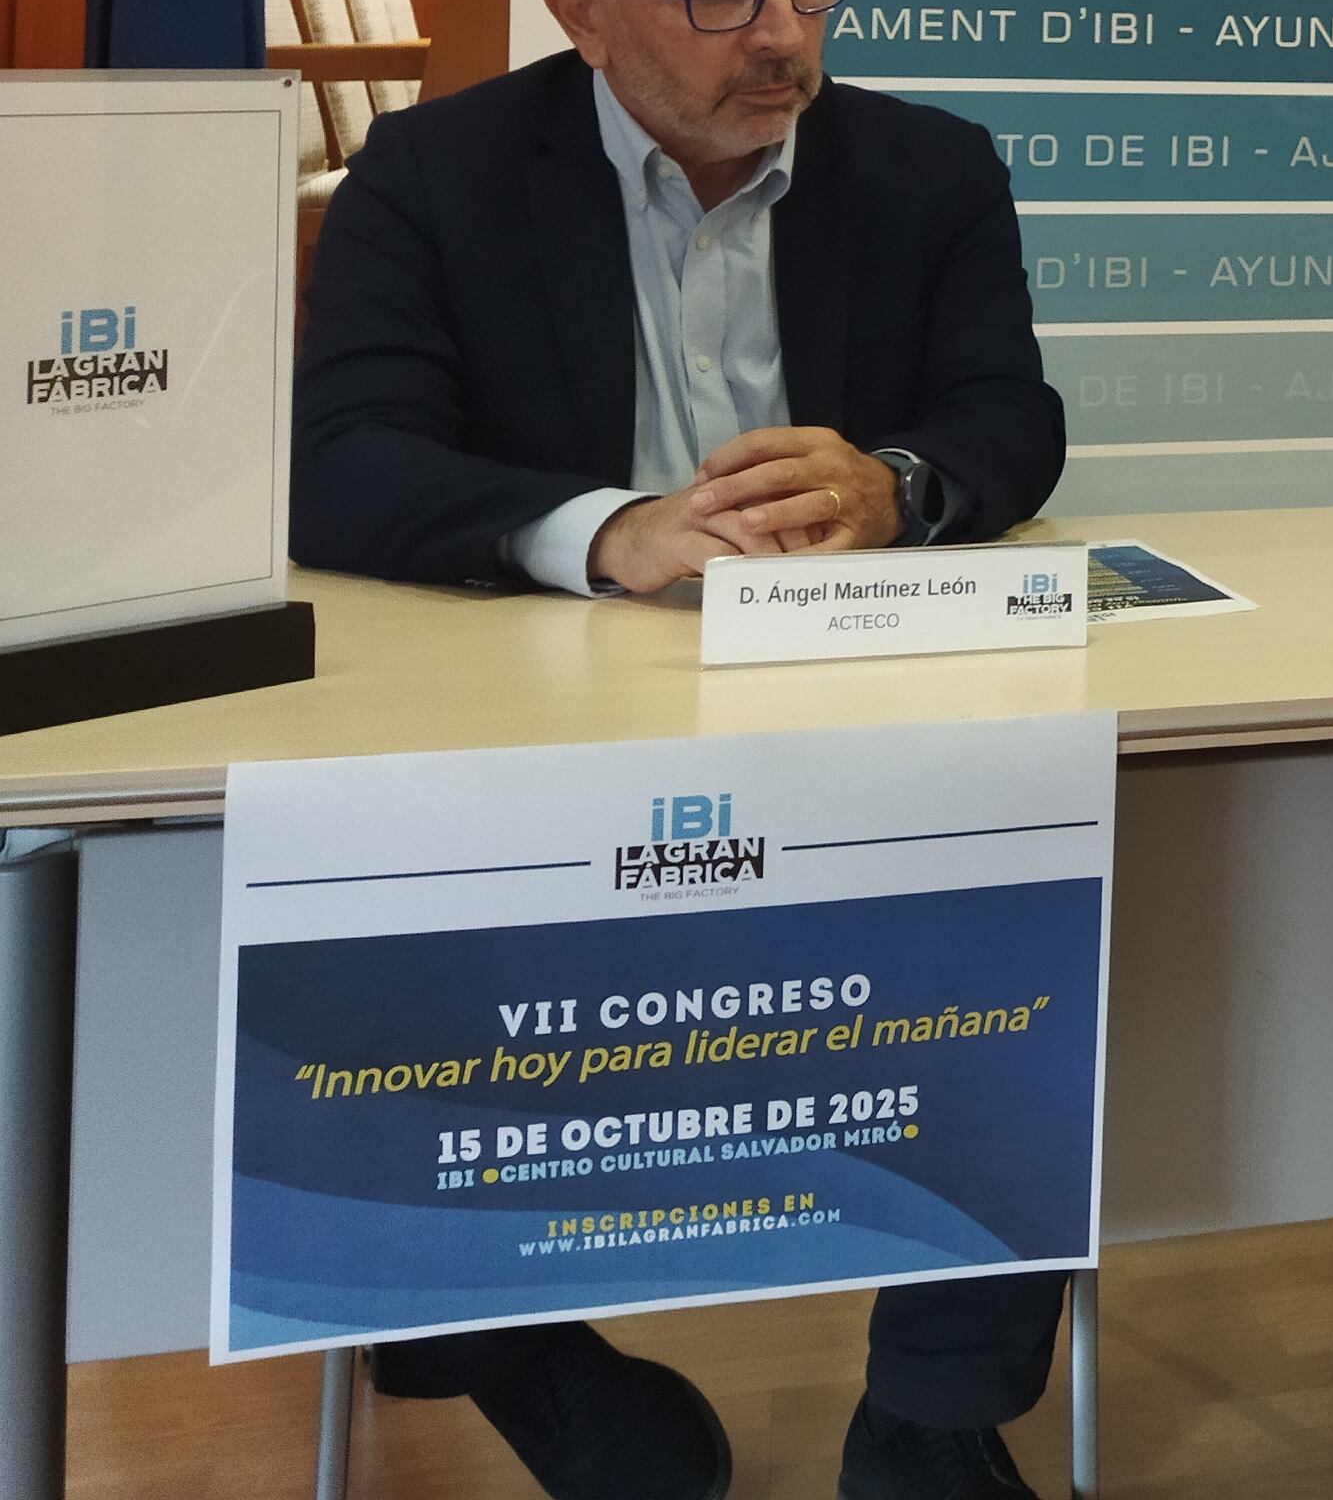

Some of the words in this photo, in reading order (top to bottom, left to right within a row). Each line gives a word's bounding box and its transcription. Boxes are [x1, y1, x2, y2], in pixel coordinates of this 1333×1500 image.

[1042, 7, 1153, 45] D'IBI
[1085, 134, 1144, 167] DE
[1171, 135, 1229, 167] IBI
[1036, 252, 1147, 289] D'IBI
[740, 586, 760, 604] D.
[767, 579, 827, 607] Ángel
[834, 579, 921, 600] Martínez
[928, 576, 976, 596] León
[827, 612, 900, 631] ACTECO
[498, 999, 577, 1038] VII
[599, 974, 871, 1029] CONGRESO
[294, 1058, 482, 1099] “Innovar
[490, 1046, 573, 1088] hoy
[578, 1041, 672, 1083] para
[684, 1025, 819, 1065] liderar
[826, 1013, 864, 1051] el
[872, 996, 1050, 1047] mañana”
[438, 1128, 482, 1164] 15
[496, 1123, 547, 1159] DE
[561, 1103, 753, 1151] OCTUBRE
[766, 1096, 815, 1131] DE
[828, 1085, 919, 1125] 2025
[437, 1168, 475, 1190] IBI
[500, 1157, 593, 1183] CENTRO
[600, 1145, 715, 1173] CULTURAL
[721, 1132, 837, 1160] SALVADOR
[844, 1122, 902, 1147] MIRÓ
[549, 1198, 770, 1237] INSCRIPCIONES
[784, 1194, 814, 1212] EN
